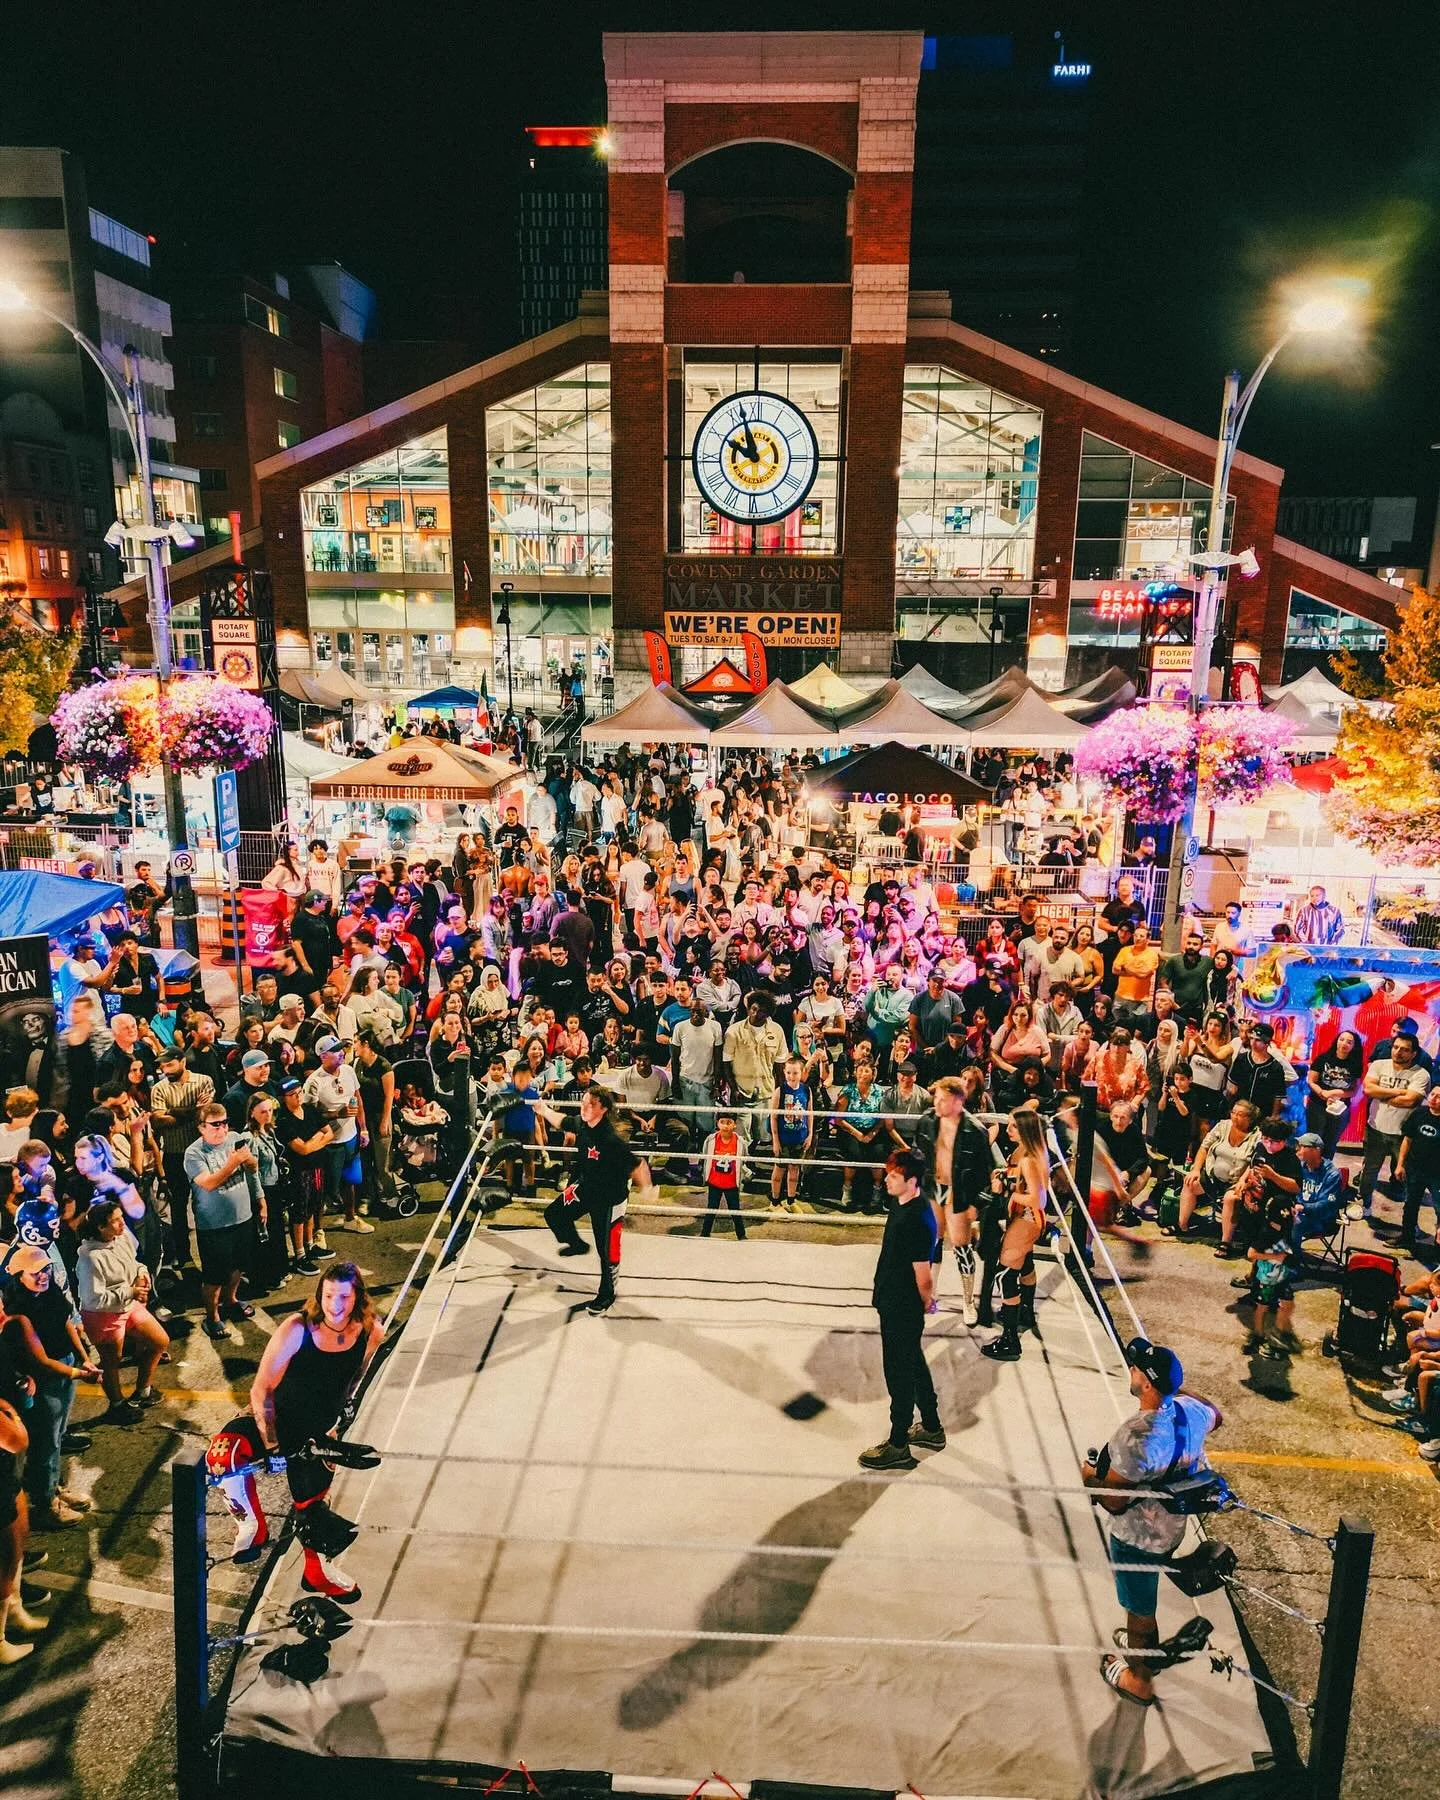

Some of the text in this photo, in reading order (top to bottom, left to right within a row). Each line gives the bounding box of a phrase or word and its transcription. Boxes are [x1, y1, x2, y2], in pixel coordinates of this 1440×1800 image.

[1054, 65, 1091, 77] FARHI
[667, 563, 840, 581] COVENT GARDEN
[668, 582, 840, 610] MARKET
[669, 615, 837, 635] WE'RE OPEN!
[669, 635, 690, 643] TUES
[704, 636, 720, 644] SAT
[783, 637, 802, 645] MON
[804, 637, 837, 645] CLOSED
[330, 785, 345, 800] LA
[433, 788, 468, 802] GRILL
[852, 792, 953, 804] TACO LOCO
[22, 860, 67, 873] DANGER
[1035, 905, 1070, 919] ANGER
